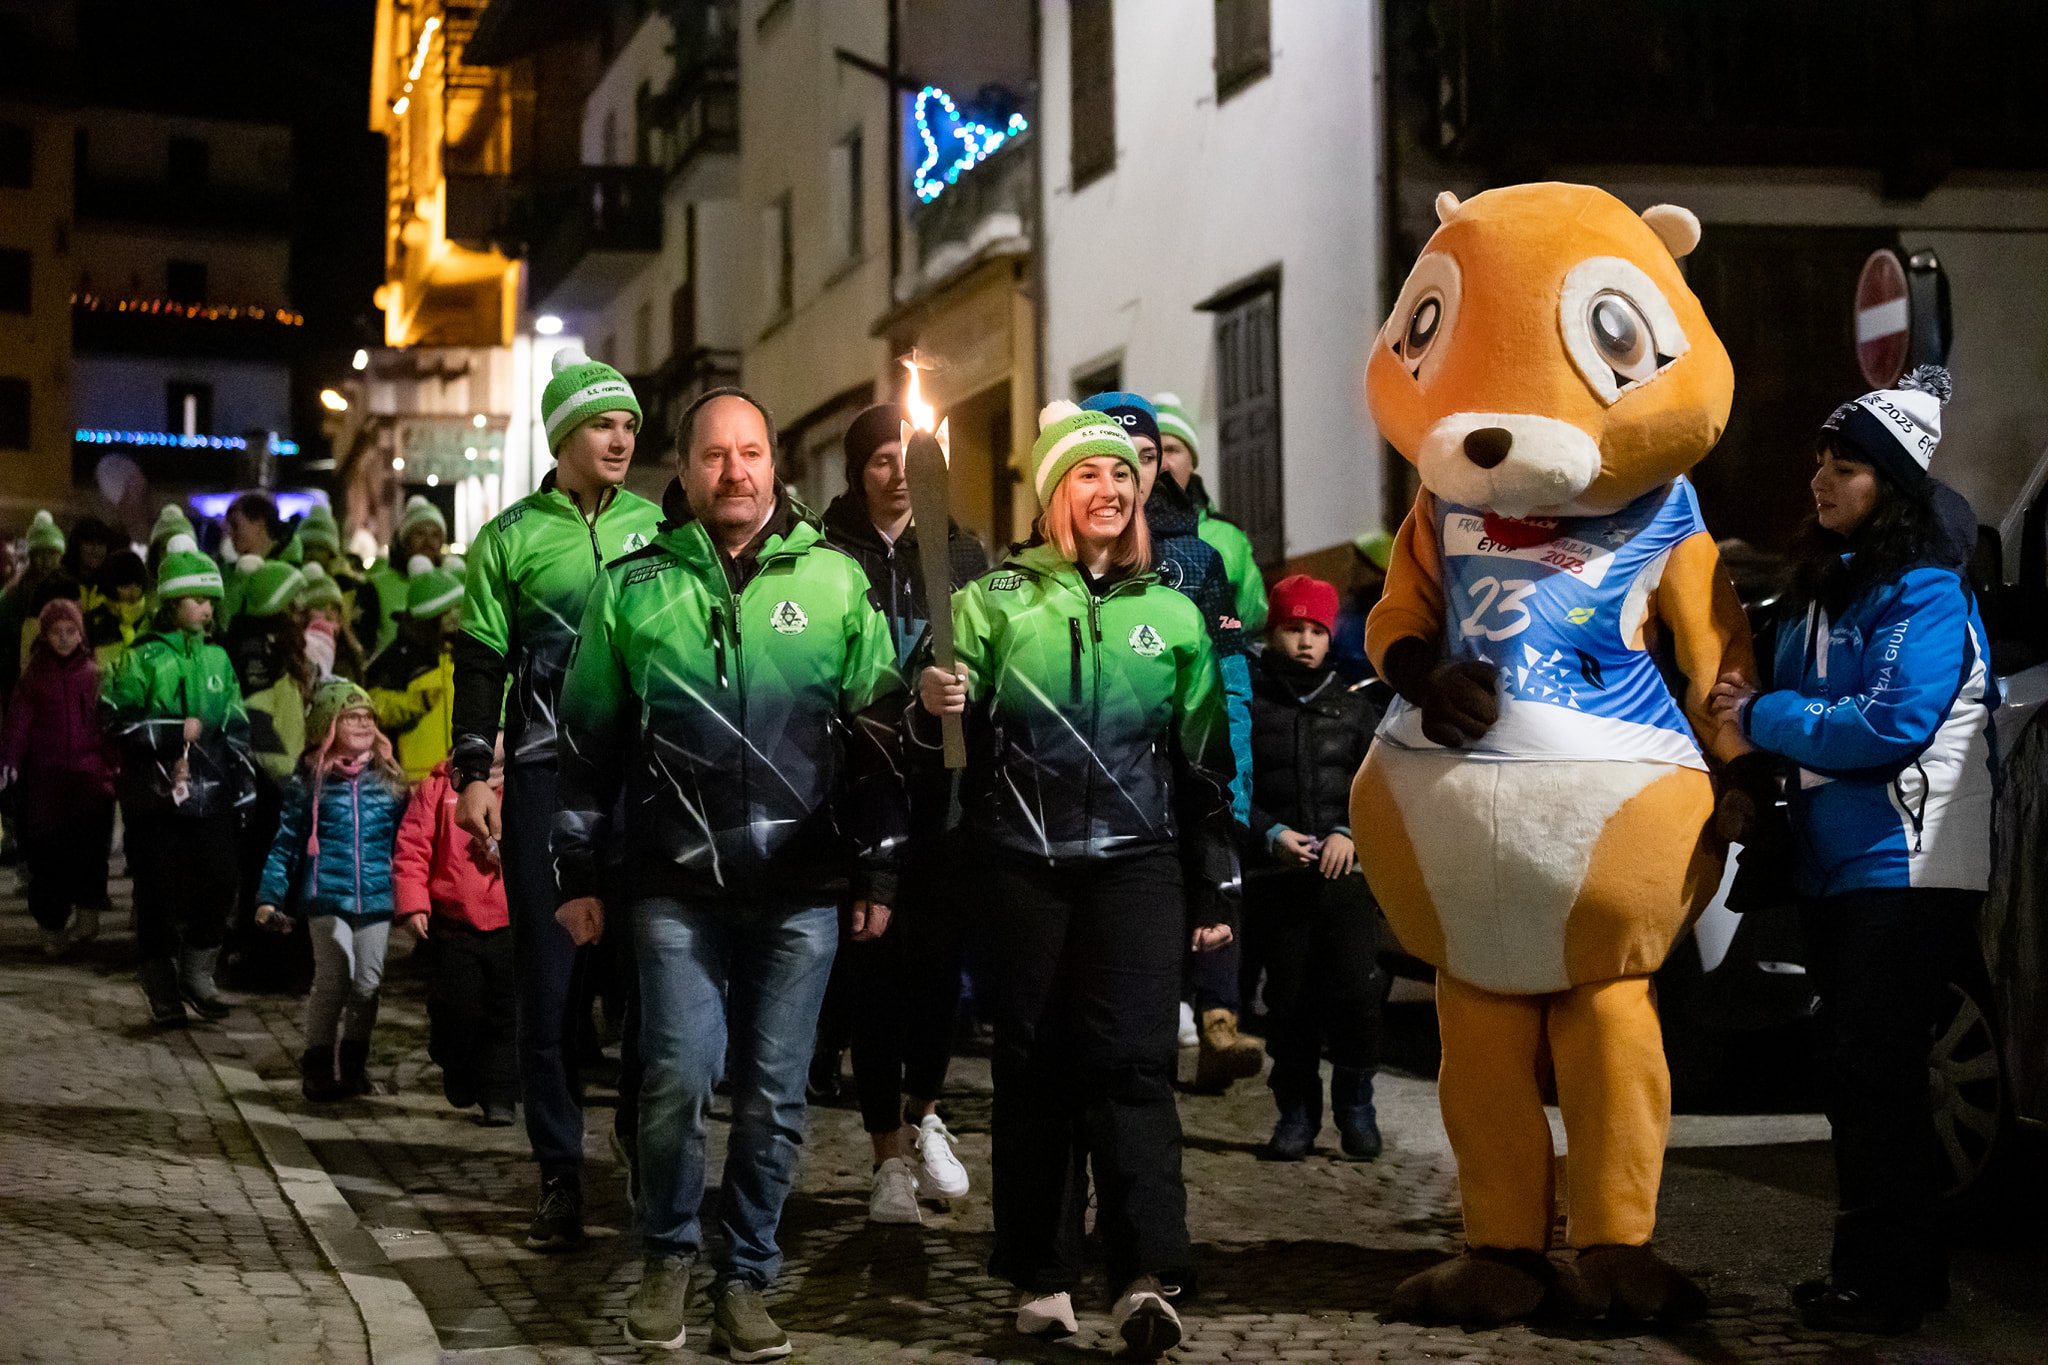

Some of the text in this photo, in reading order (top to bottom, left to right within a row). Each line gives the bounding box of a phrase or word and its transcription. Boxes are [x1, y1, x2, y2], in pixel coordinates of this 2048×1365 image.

[1111, 414, 1137, 426] OC
[1880, 402, 1914, 434] 2023
[1458, 518, 1485, 533] FRIUL
[1540, 551, 1586, 575] 2023
[1459, 576, 1537, 642] 23
